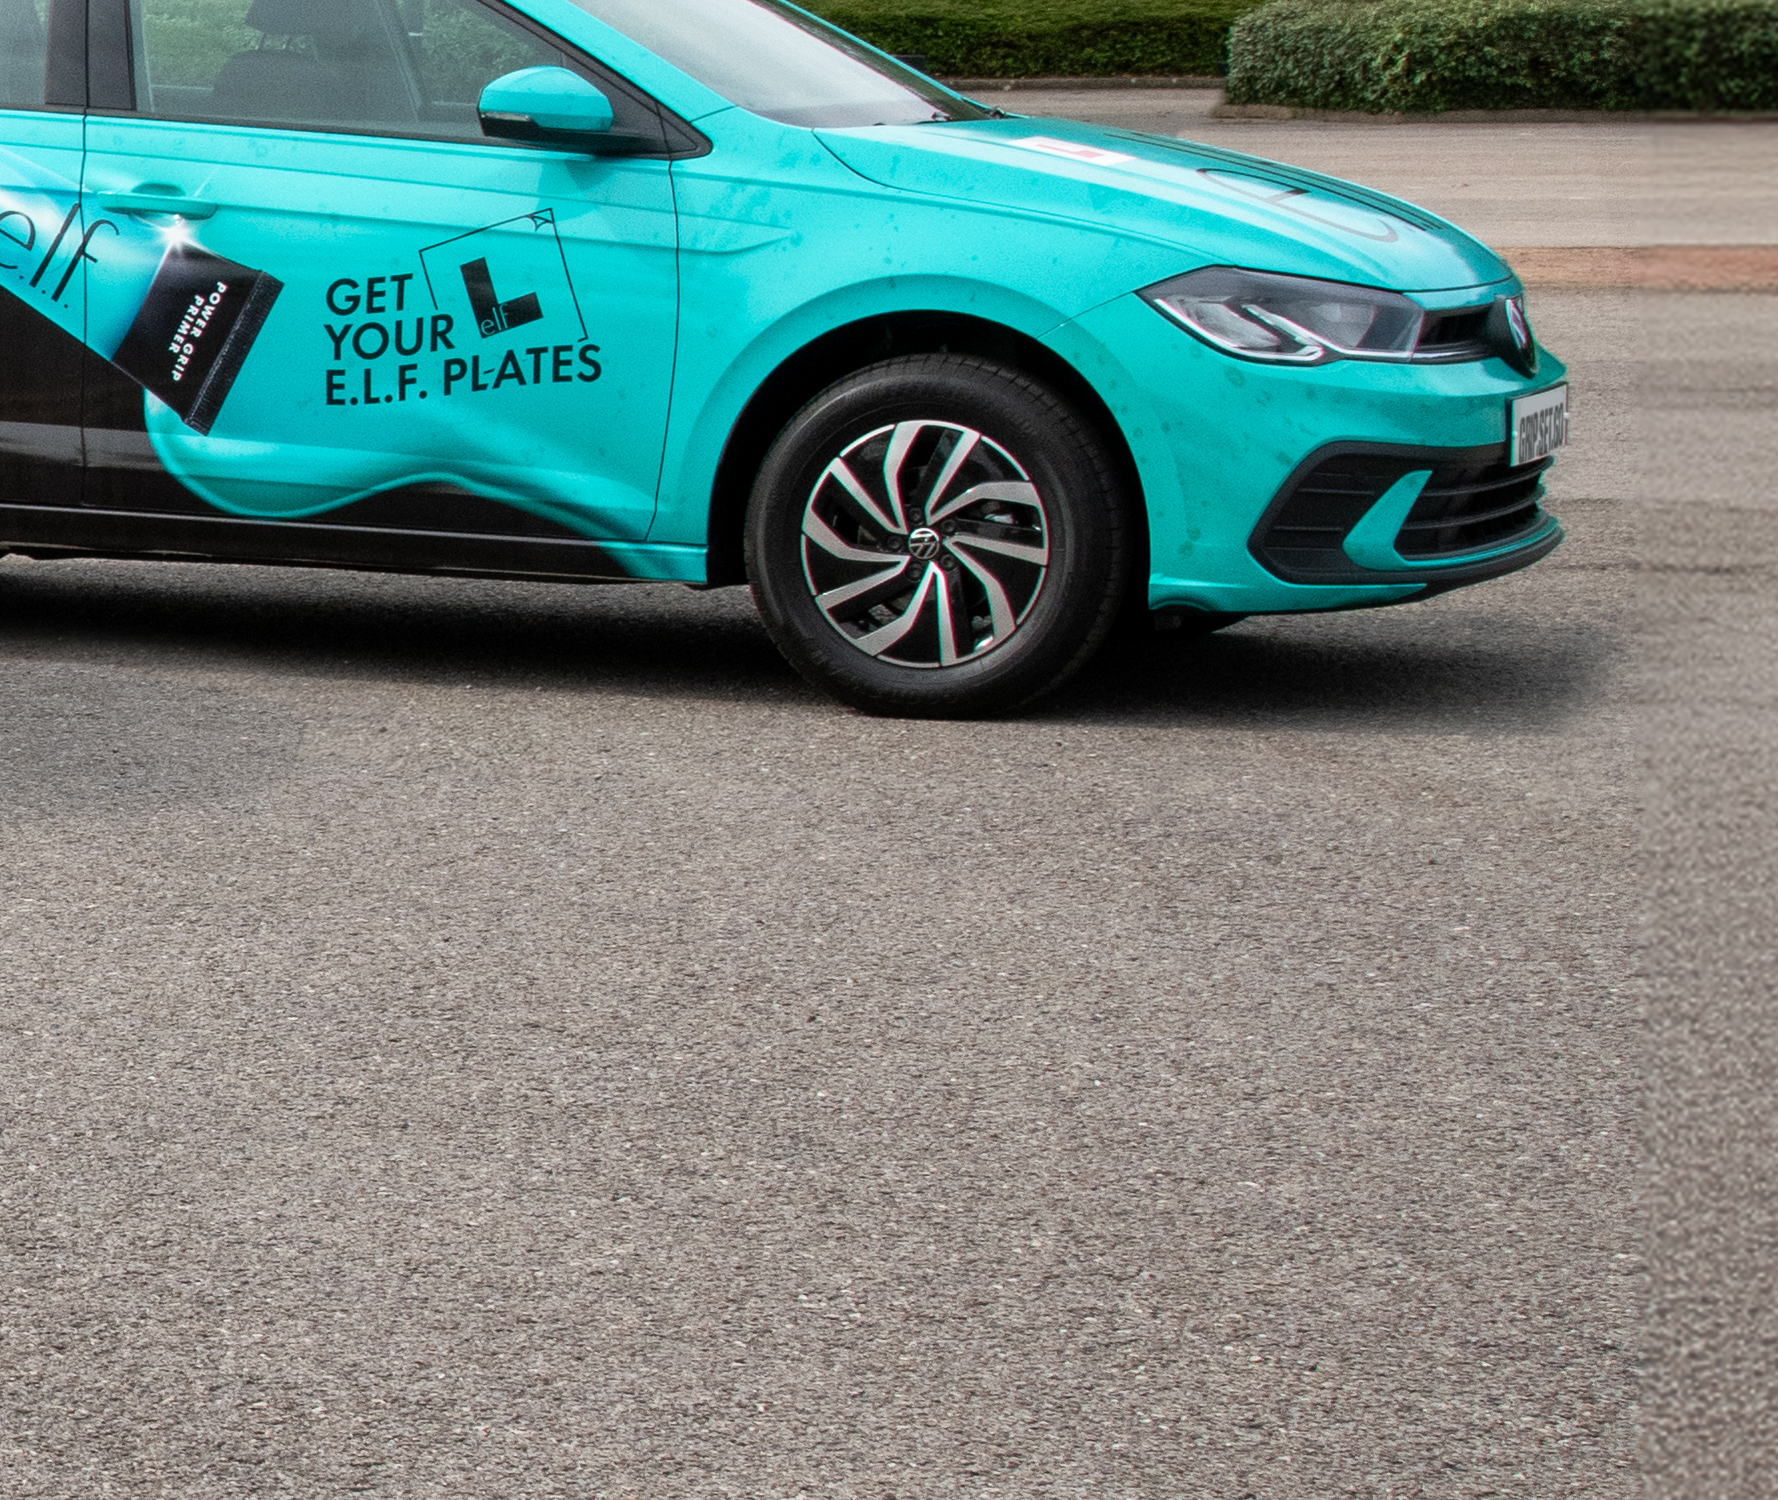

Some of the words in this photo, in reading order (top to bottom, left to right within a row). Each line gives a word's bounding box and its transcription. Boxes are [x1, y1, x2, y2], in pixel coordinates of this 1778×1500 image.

[190, 281, 228, 338] POWER
[326, 273, 413, 316] GET
[168, 294, 205, 354] PRIMER
[323, 314, 456, 360] YOUR
[171, 343, 194, 381] GRIP
[326, 363, 428, 406] E.L.F.
[443, 343, 602, 396] PLATES
